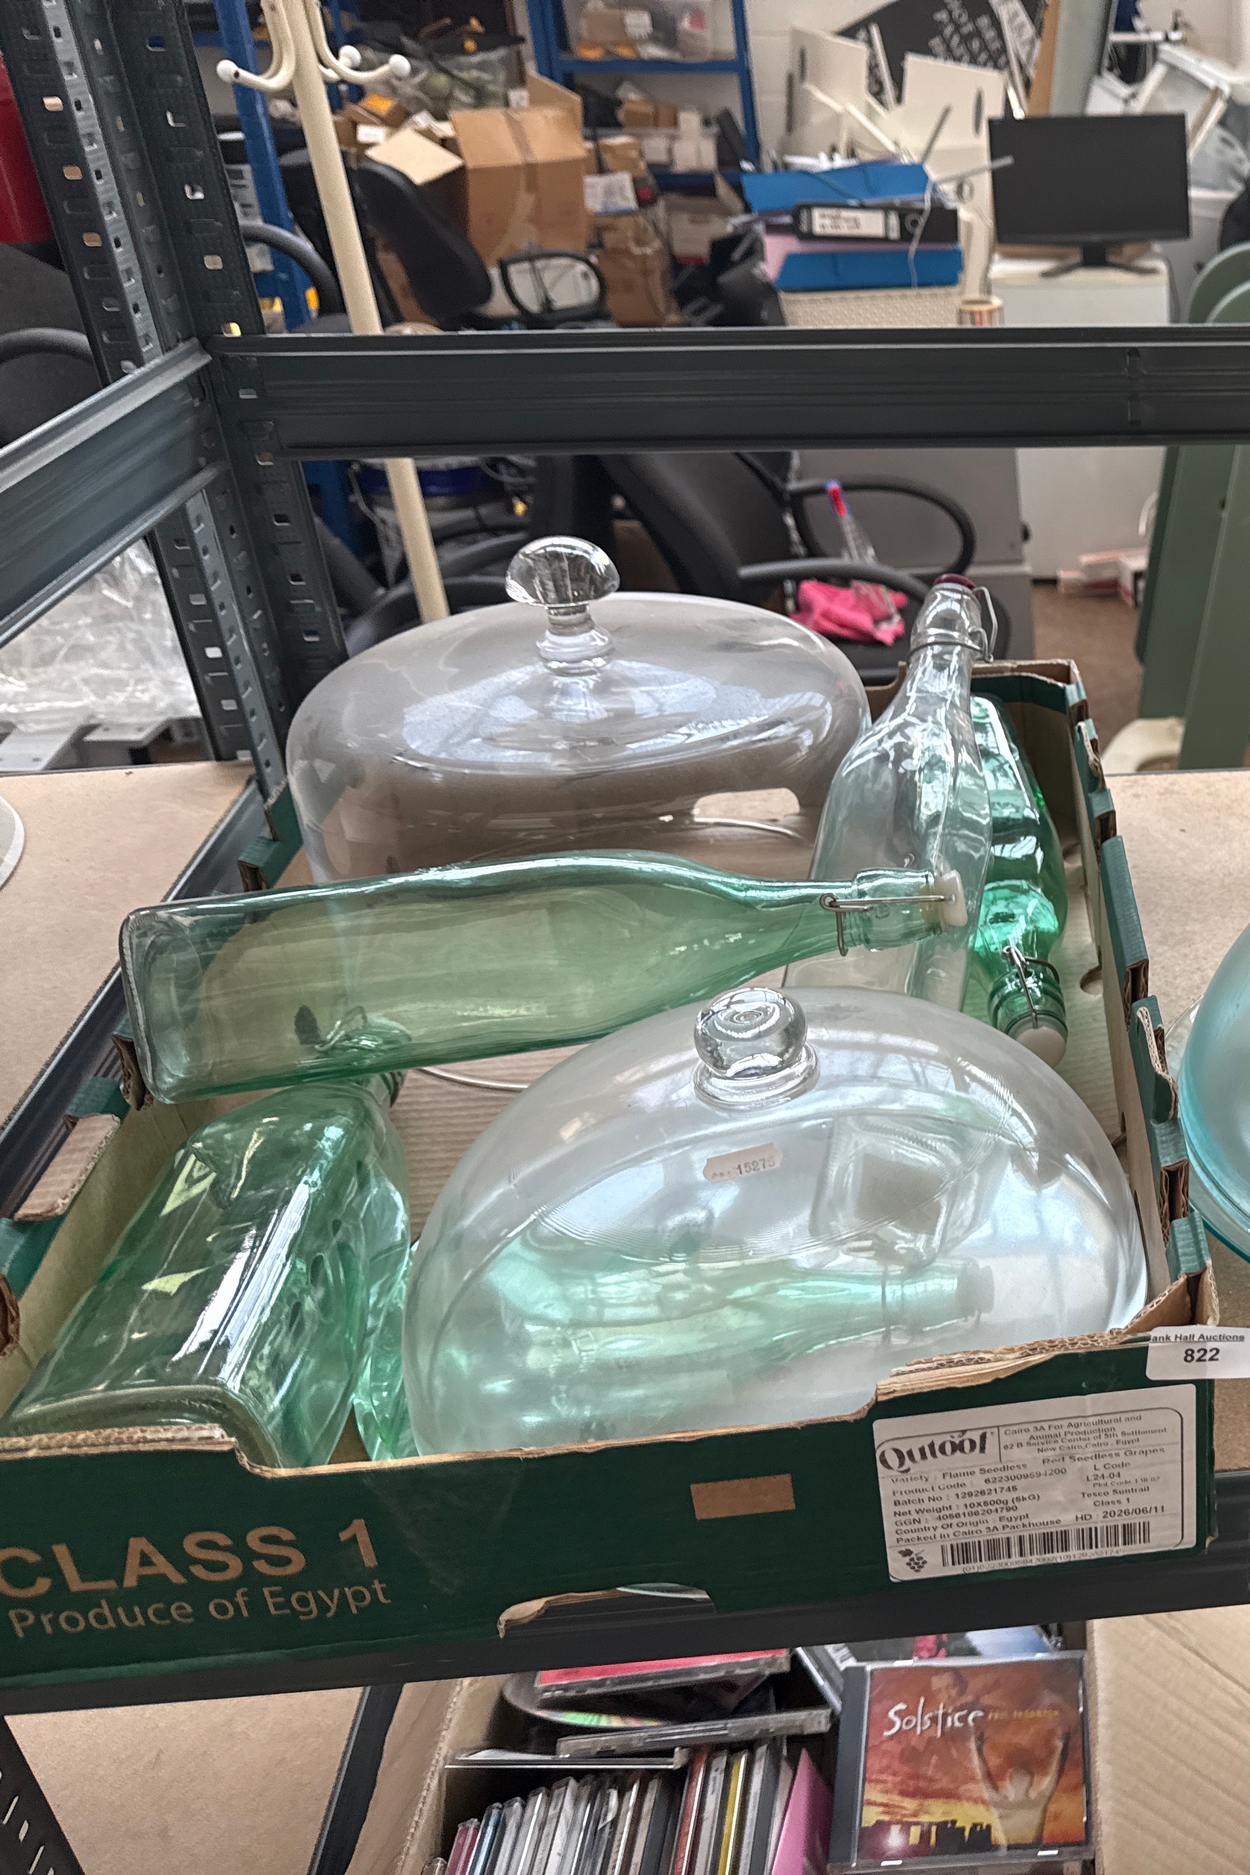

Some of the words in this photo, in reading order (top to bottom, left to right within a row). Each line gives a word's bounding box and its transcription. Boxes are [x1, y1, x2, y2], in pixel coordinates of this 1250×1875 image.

[1174, 1333, 1195, 1342] Hall
[1197, 1333, 1245, 1342] Auctions
[1183, 1347, 1221, 1363] 822
[1004, 1427, 1031, 1436] Cairo
[1032, 1425, 1046, 1433] 3A
[1048, 1423, 1064, 1431] For
[1066, 1415, 1122, 1430] Agricultural
[1124, 1414, 1143, 1422] and
[1029, 1432, 1062, 1441] Animal
[1063, 1426, 1116, 1438] Production
[1042, 1456, 1065, 1465] Red
[1068, 1451, 1121, 1463] Seedless
[1124, 1447, 1166, 1458] Grapes
[891, 1473, 930, 1484] Variety
[942, 1469, 976, 1480] Flame
[979, 1462, 1028, 1474] Seedless
[1103, 1461, 1131, 1470] Code
[938, 1482, 967, 1491] Code
[1081, 1489, 1110, 1499] Tesco
[893, 1497, 925, 1507] Batch
[927, 1494, 943, 1503] No
[1093, 1498, 1122, 1508] Class
[893, 1508, 913, 1518] Net
[914, 1504, 953, 1516] Weight
[1075, 1513, 1093, 1522] HD
[1102, 1504, 1165, 1520] 2026/06/11
[894, 1518, 922, 1528] GGN
[895, 1524, 939, 1537] Country
[941, 1522, 954, 1531] Of
[955, 1518, 990, 1530] Origin
[998, 1512, 1030, 1525] Egypt
[896, 1533, 938, 1544] Packed
[953, 1528, 983, 1539] Cairo
[985, 1524, 1000, 1534] 3A
[1002, 1518, 1062, 1532] Packhouse
[0, 1526, 306, 1599] CLASS
[339, 1518, 379, 1569] 1
[8, 1599, 195, 1638] Produce
[208, 1587, 250, 1620] of
[263, 1579, 392, 1621] Egypt
[882, 1695, 985, 1739] Solstice
